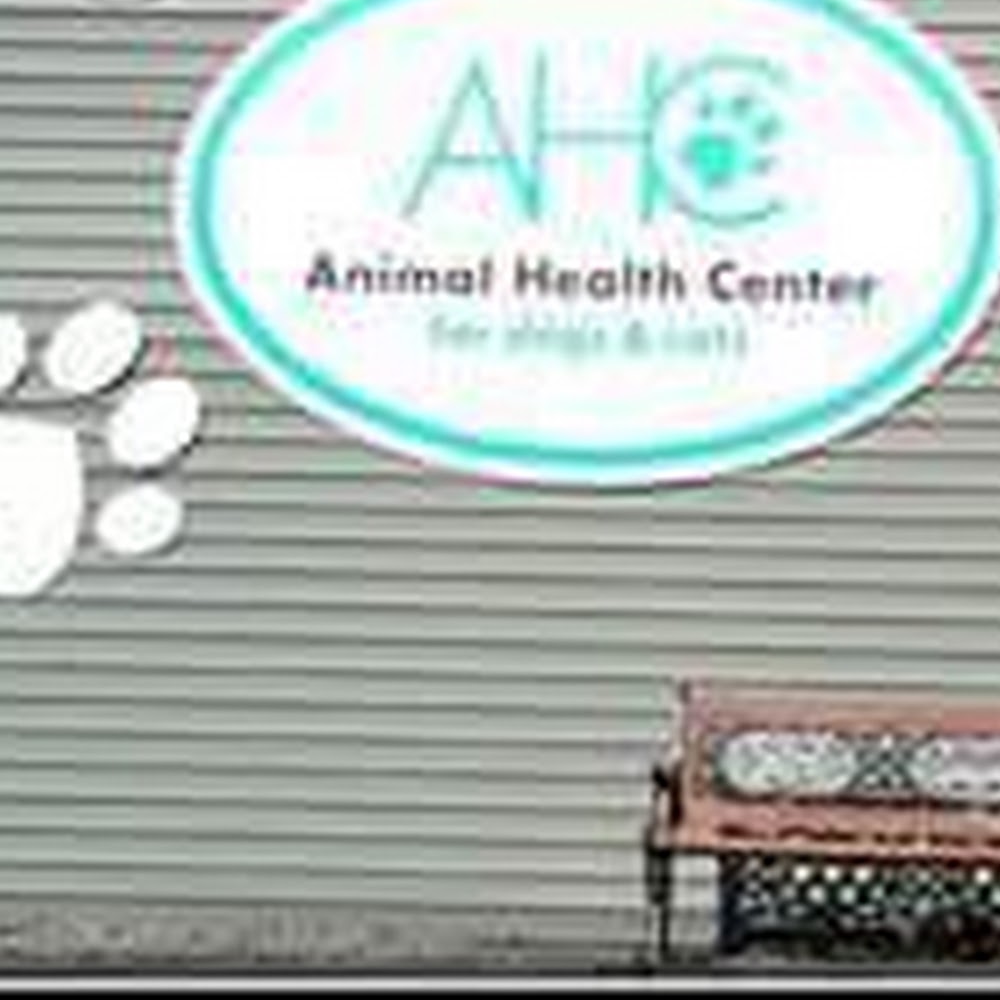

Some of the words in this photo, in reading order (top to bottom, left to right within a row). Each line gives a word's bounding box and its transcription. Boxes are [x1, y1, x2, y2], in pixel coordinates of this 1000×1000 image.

[400, 50, 790, 228] AHC
[304, 250, 493, 296] Animal
[513, 252, 687, 302] Health
[707, 259, 880, 305] Center
